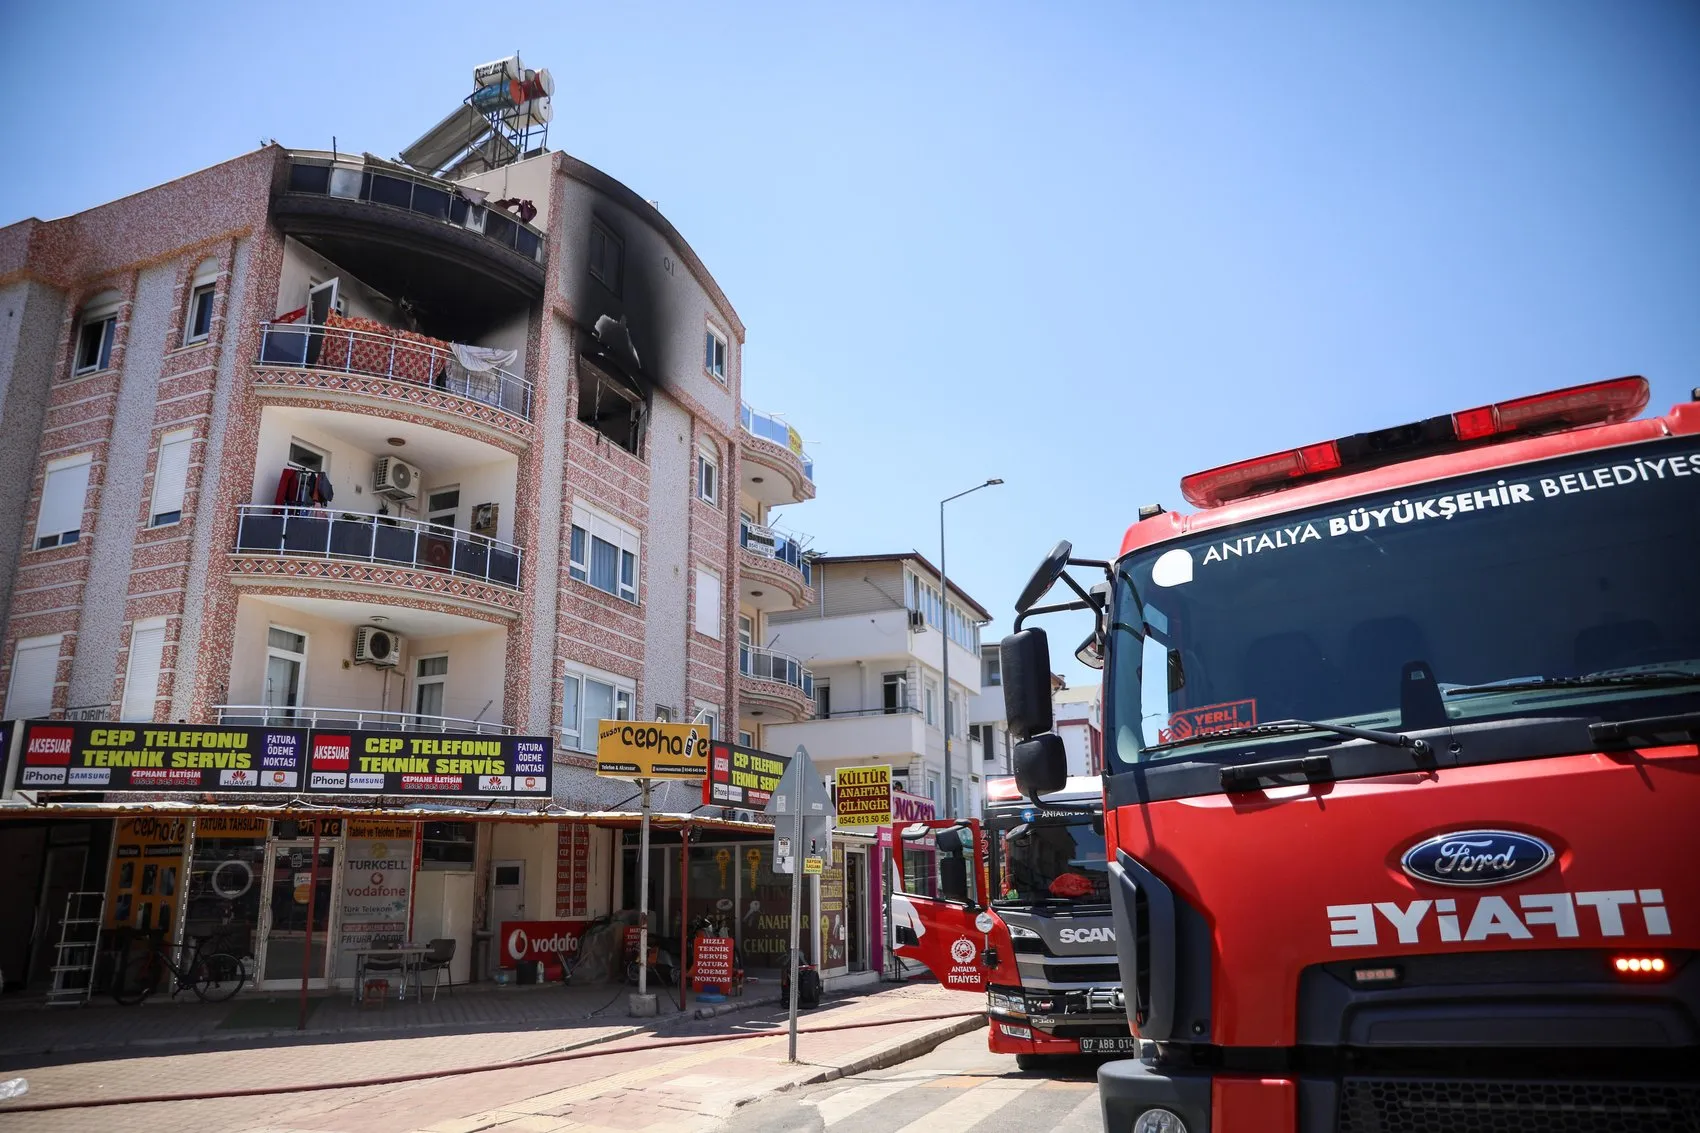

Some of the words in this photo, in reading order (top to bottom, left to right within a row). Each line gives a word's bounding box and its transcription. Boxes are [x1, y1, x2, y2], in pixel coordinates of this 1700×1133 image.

[1202, 523, 1322, 566] ANTALYA
[1329, 480, 1535, 538] BÜYÜKŞEHİR
[1540, 454, 1700, 498] BELEDİYES
[1194, 703, 1237, 726] YERLİ
[90, 729, 136, 746] CEP
[144, 730, 249, 748] TELEFONU
[266, 735, 297, 745] FATURA
[28, 738, 72, 754] AKSESUAR
[267, 745, 294, 756] ÖDEME
[365, 738, 404, 753] CEP
[410, 739, 502, 756] TELEFONU
[517, 743, 543, 752] FATURA
[82, 748, 165, 767] TEKNİK
[171, 749, 252, 769] SERVİS
[313, 745, 350, 760] AKSESUAR
[518, 752, 542, 762] ÖDEME
[359, 755, 429, 773] TEKNİK
[436, 757, 506, 775] SERVİS
[515, 763, 545, 773] NOKTASI
[733, 751, 749, 769] CEP
[750, 755, 784, 776] TELEFONU
[25, 771, 64, 781] iPhone
[168, 771, 201, 780] İLETİŞİM
[312, 775, 345, 785] iPhone
[434, 776, 463, 784] İLETİŞİM
[732, 770, 759, 789] TEKNİK
[760, 776, 782, 792] SERV
[839, 769, 888, 786] KÜLTÜR
[840, 786, 889, 798] ANAHTAR
[839, 798, 889, 815] ÇİLİNGİR
[200, 817, 227, 831] FATURA
[840, 817, 855, 825] 0542
[858, 816, 869, 824] 613
[871, 815, 879, 823] 50
[881, 814, 890, 823] 56
[1436, 840, 1517, 873] Ford
[348, 860, 408, 870] TURKCELL
[346, 885, 406, 897] vodafone
[362, 905, 393, 913] Telekom
[758, 914, 810, 930] ANAHR
[342, 935, 372, 944] FATURA
[1060, 928, 1117, 944] SCAN
[531, 932, 579, 953] vodafo
[743, 934, 787, 956] ÇEKİLİR
[697, 945, 730, 953] TEKNİK
[697, 967, 728, 975] ÖDEME
[948, 972, 981, 984] İTFAİYESİ
[1083, 1039, 1093, 1050] 07
[1099, 1039, 1114, 1050] ABB
